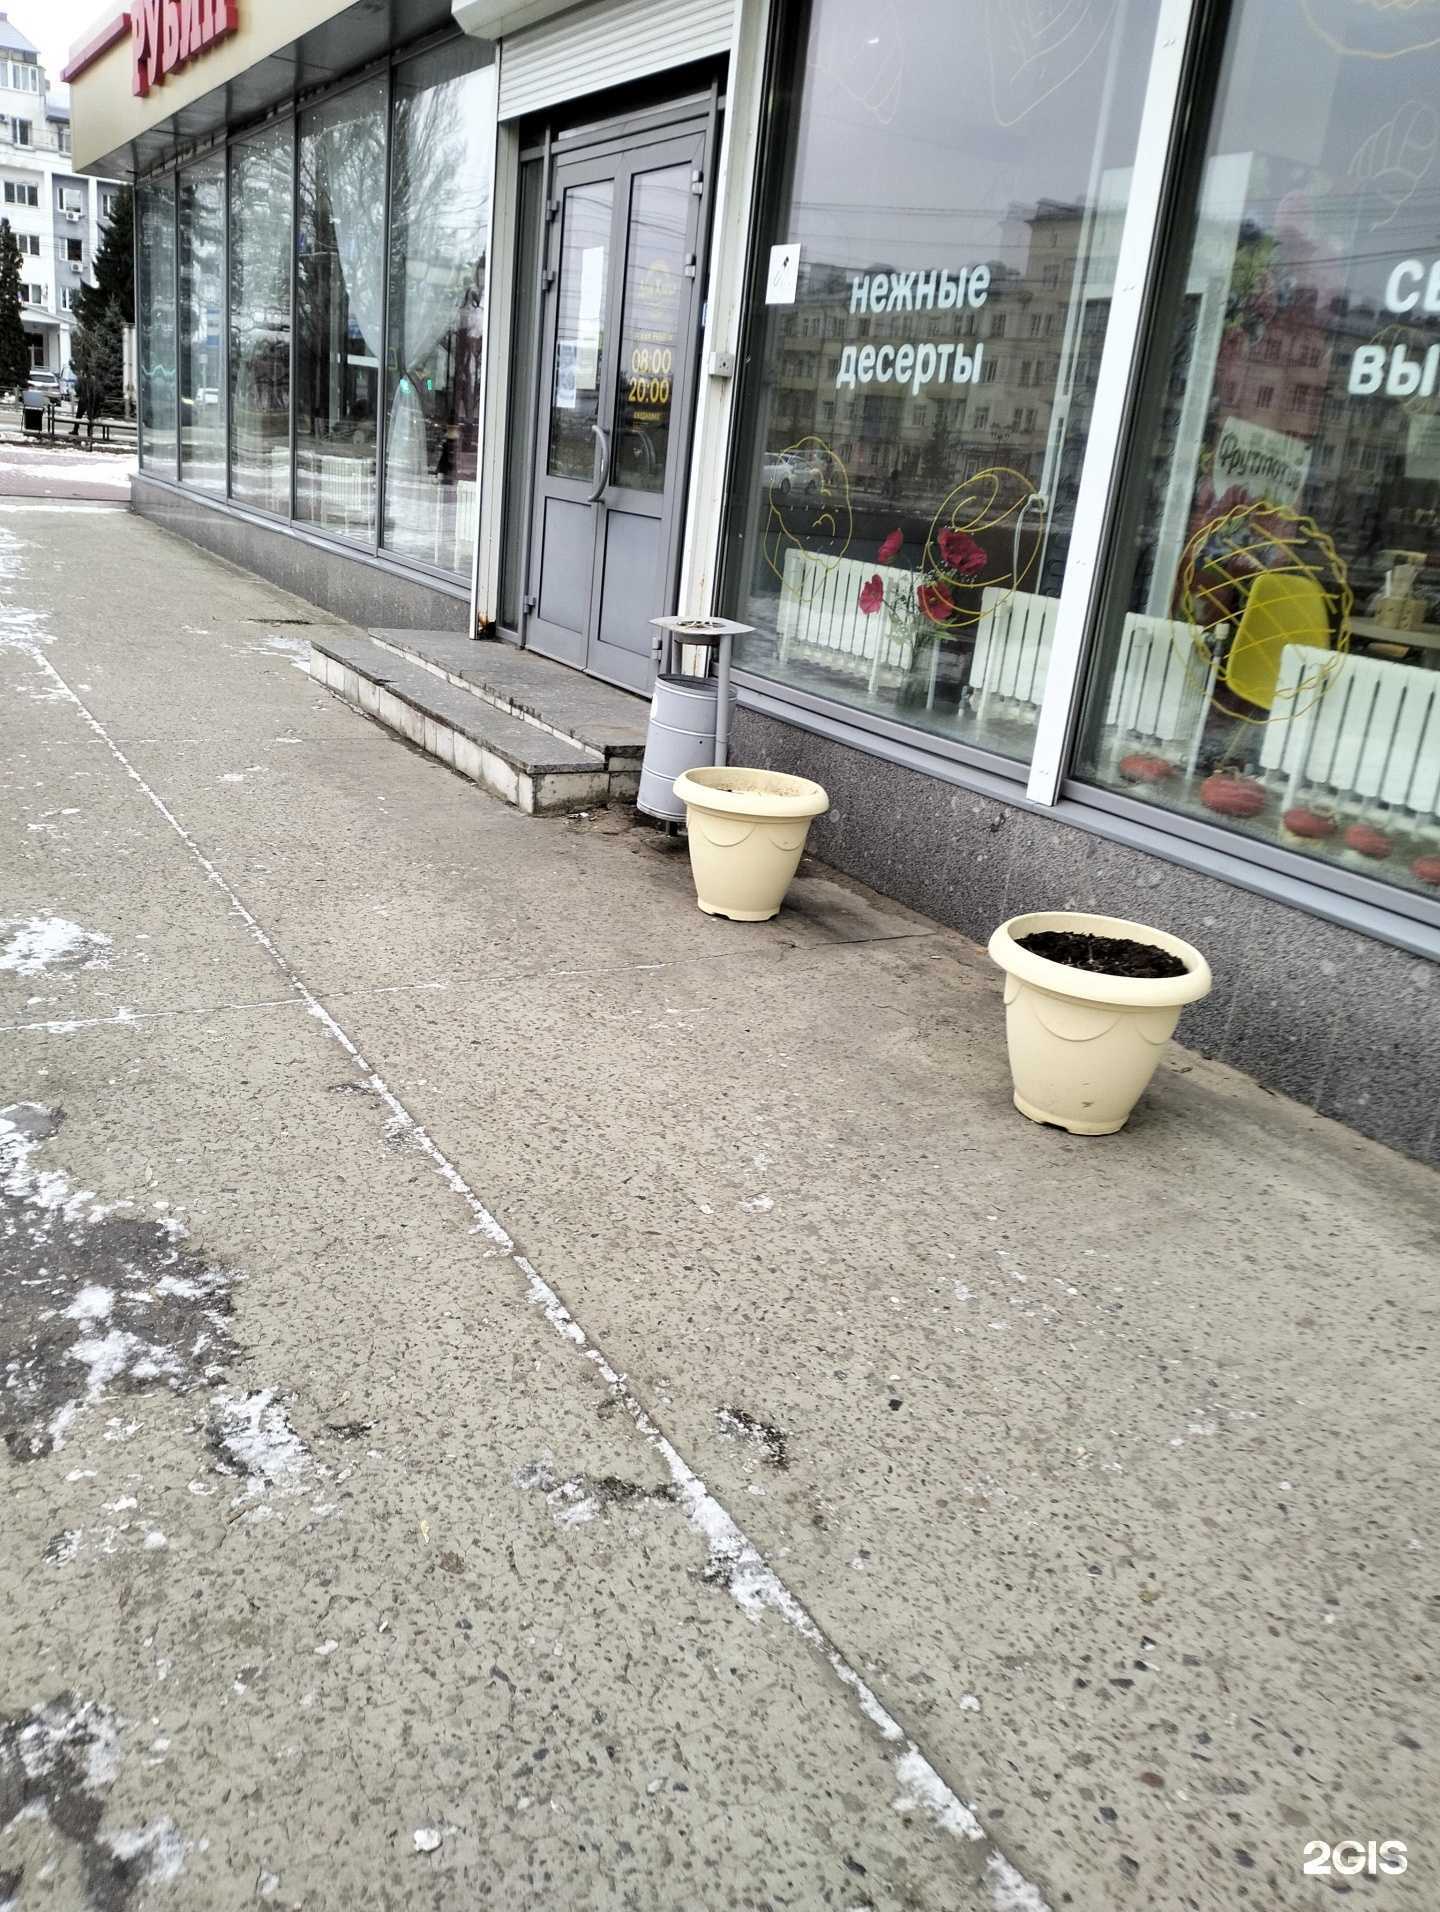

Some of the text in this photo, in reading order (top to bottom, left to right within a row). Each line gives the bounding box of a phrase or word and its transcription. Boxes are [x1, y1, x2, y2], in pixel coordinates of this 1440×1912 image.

[850, 264, 991, 314] нежные
[631, 348, 672, 374] 08:00
[836, 342, 984, 396] десерты
[628, 376, 669, 403] 20:00
